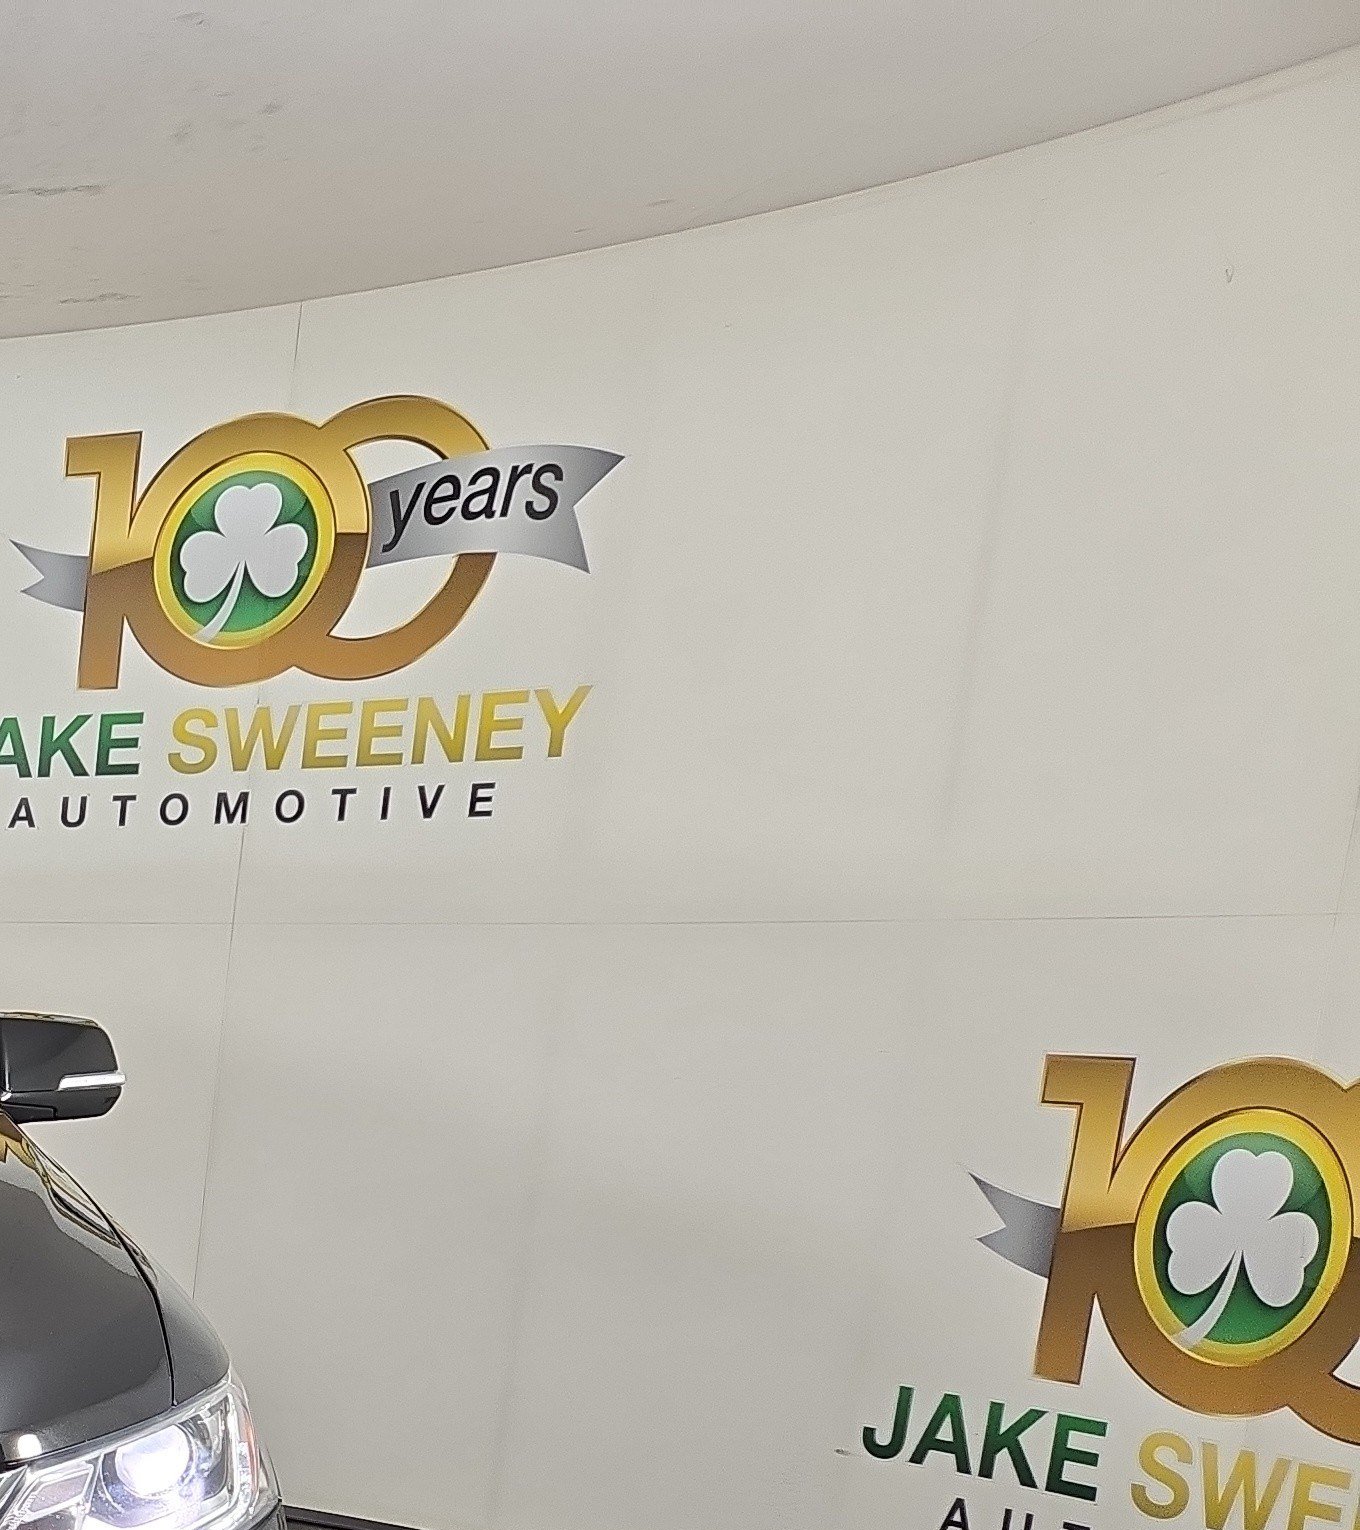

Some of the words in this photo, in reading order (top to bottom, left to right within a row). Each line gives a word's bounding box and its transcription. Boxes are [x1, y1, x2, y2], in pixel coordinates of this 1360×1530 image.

[382, 462, 565, 553] years
[167, 685, 593, 775] SWEENEY
[8, 783, 497, 831] AUTOMOTIVE
[862, 1386, 1108, 1503] JAKE
